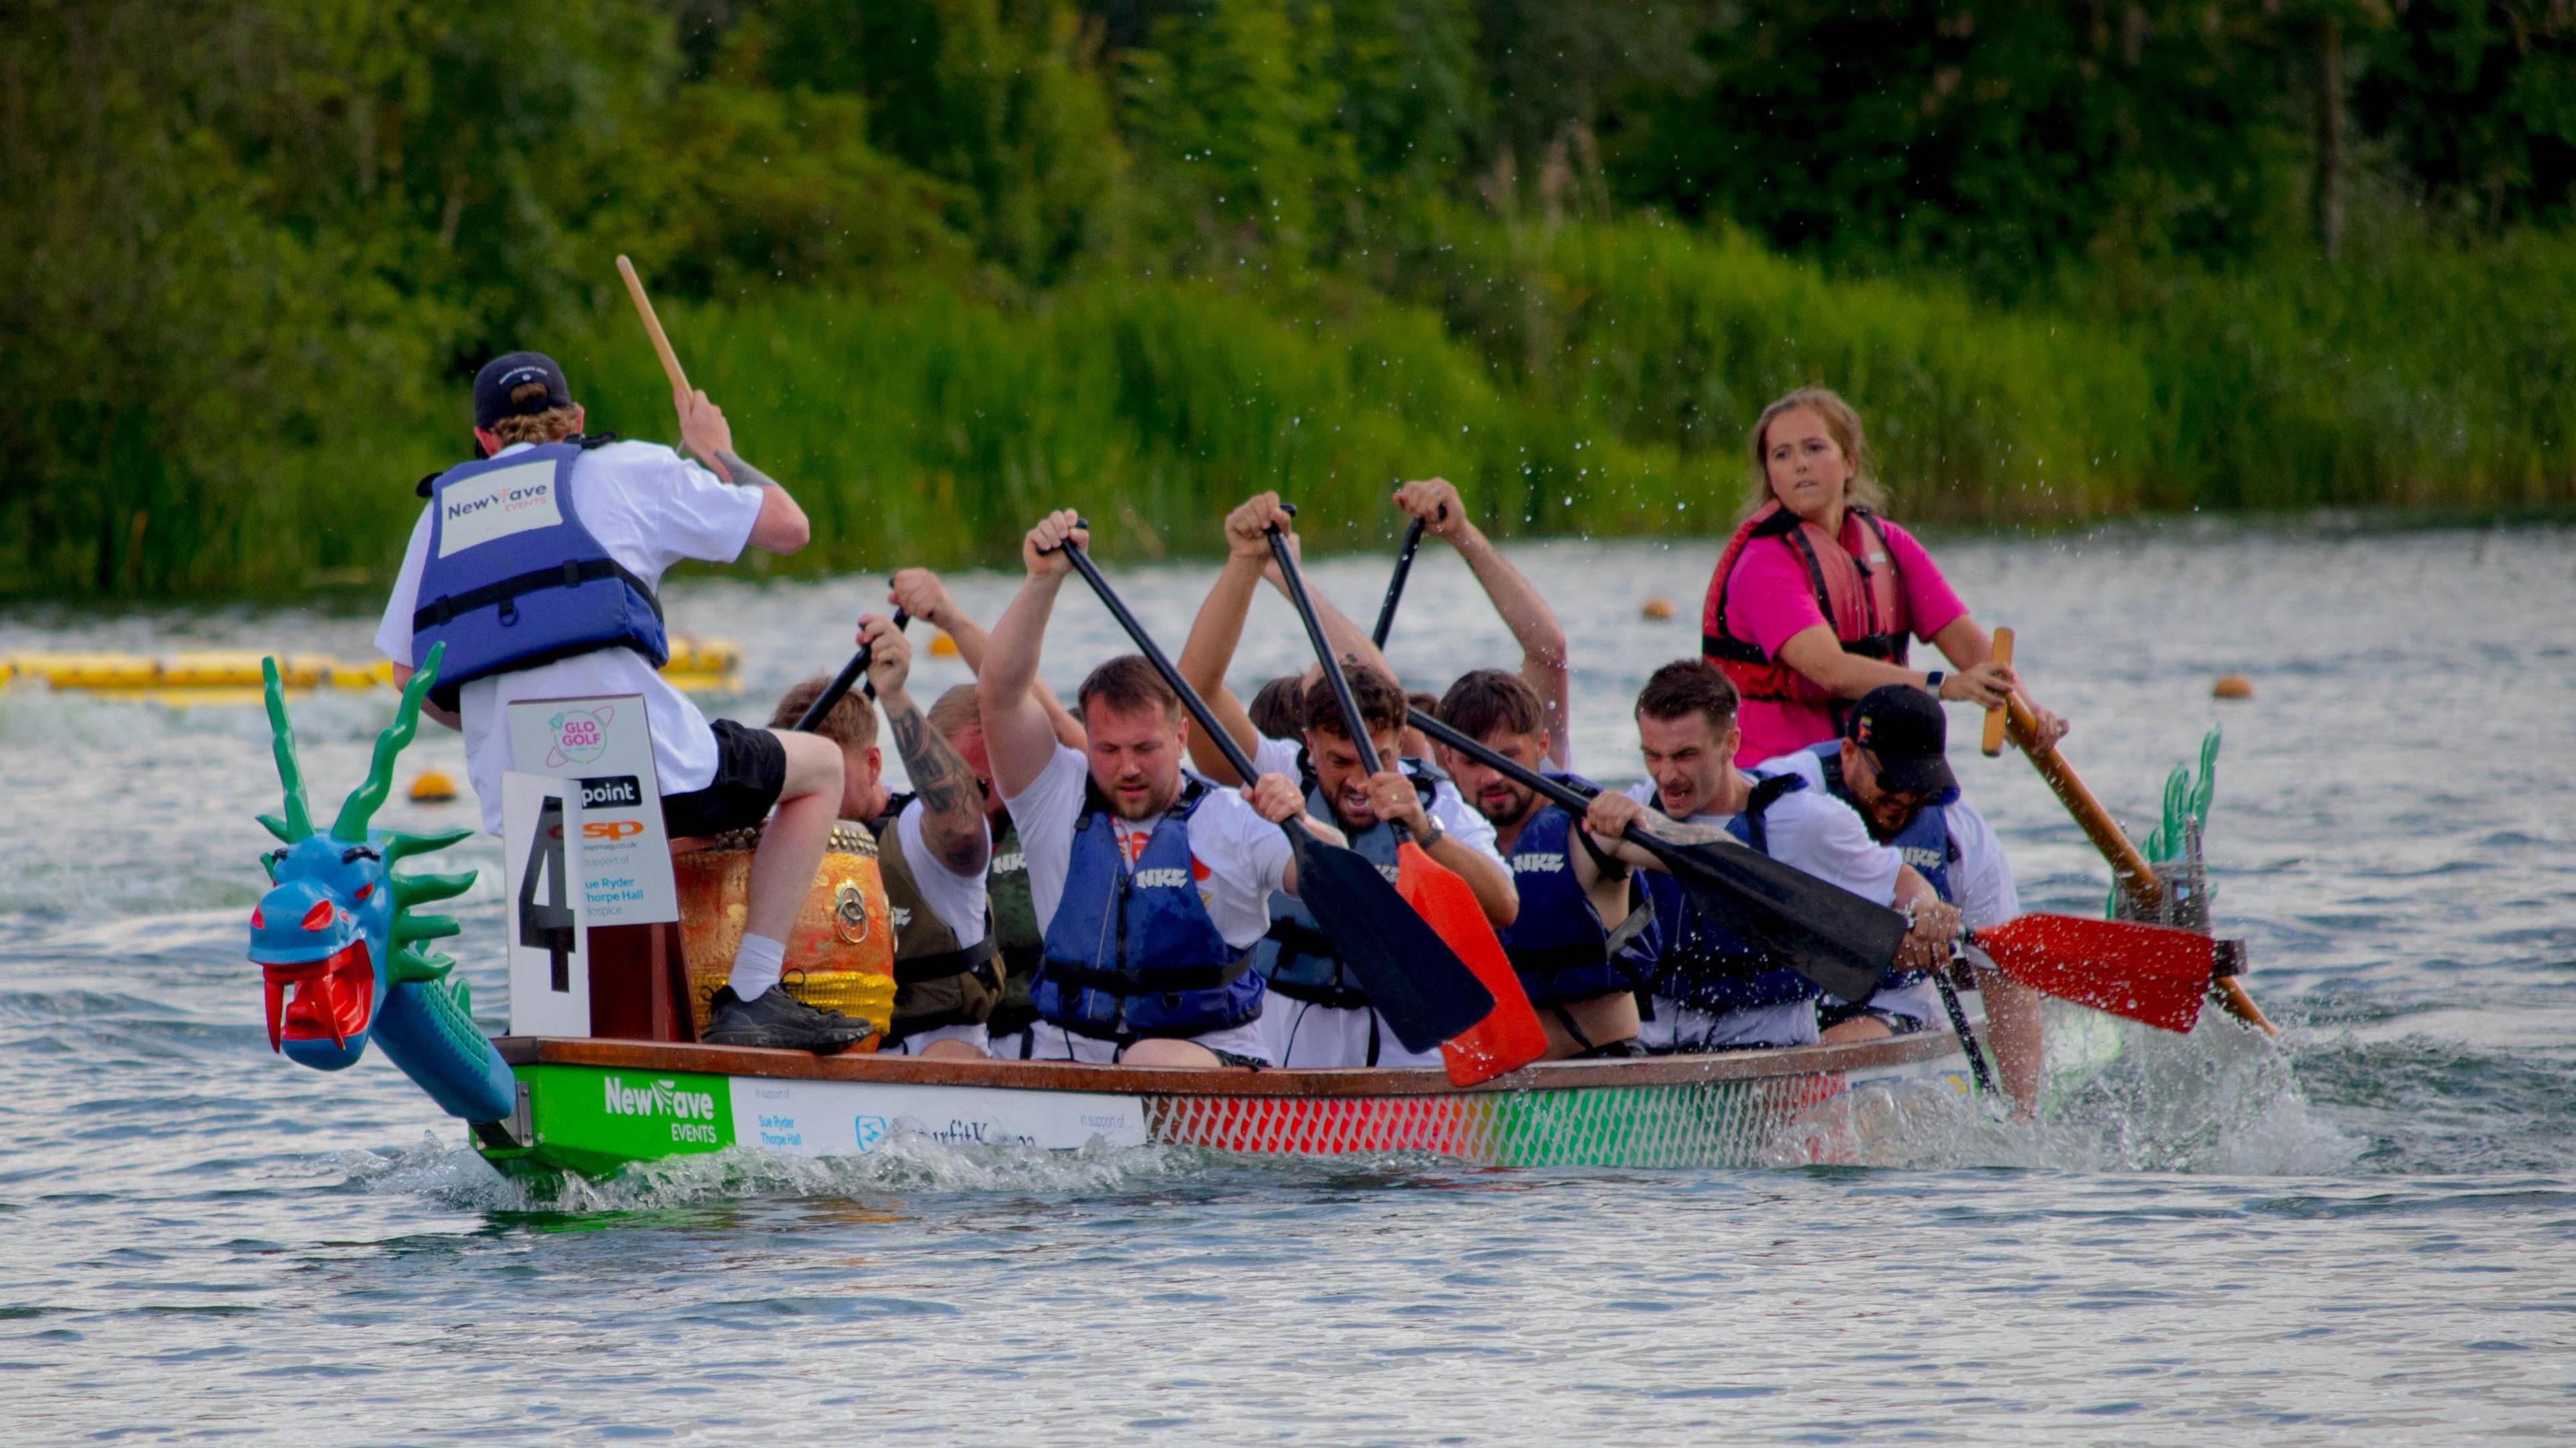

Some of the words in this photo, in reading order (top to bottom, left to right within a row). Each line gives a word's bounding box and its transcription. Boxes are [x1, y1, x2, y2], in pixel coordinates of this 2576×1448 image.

[504, 496, 547, 512] EVENTS
[565, 721, 596, 734] GLO
[562, 733, 600, 746] GOLF
[585, 880, 599, 889] ue
[602, 877, 634, 890] Ryder
[519, 795, 576, 993] 4
[586, 893, 619, 903] horpe
[622, 889, 643, 901] Hall
[757, 1114, 772, 1127] Sue
[773, 1115, 794, 1130] Ryder
[672, 1122, 716, 1144] EVENTS
[761, 1131, 786, 1147] Thorpe
[787, 1133, 802, 1146] Hall
